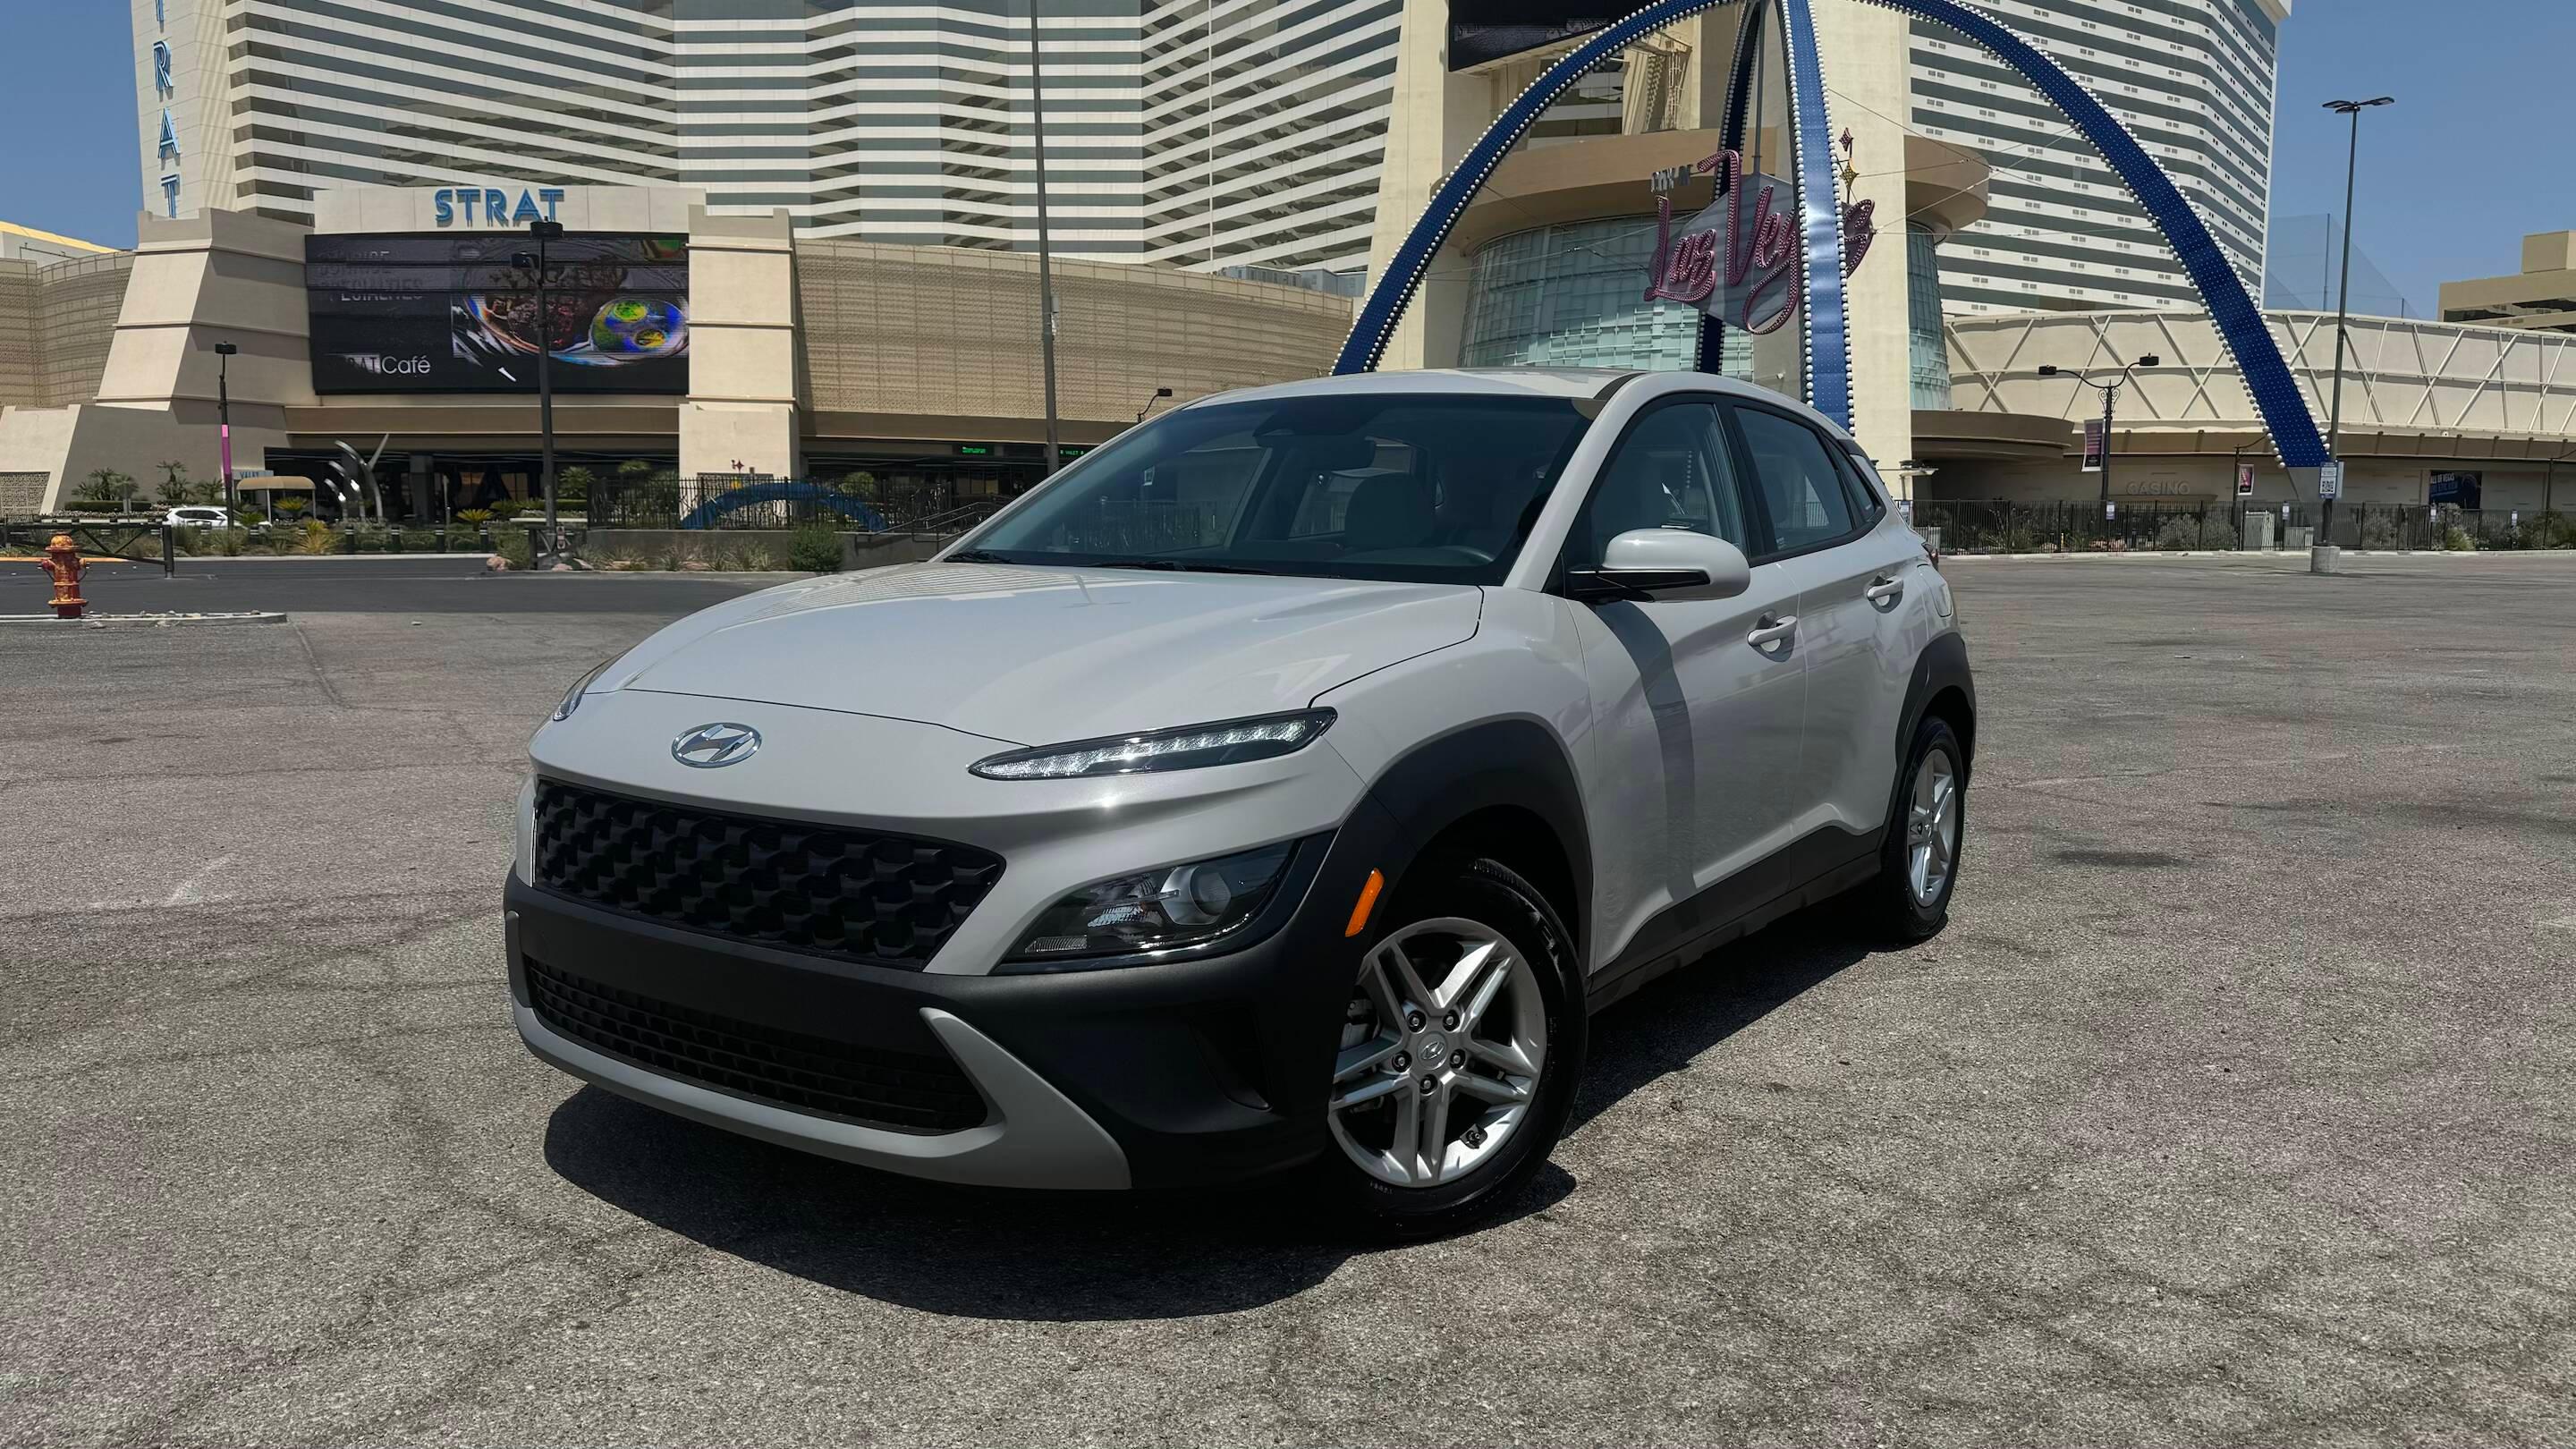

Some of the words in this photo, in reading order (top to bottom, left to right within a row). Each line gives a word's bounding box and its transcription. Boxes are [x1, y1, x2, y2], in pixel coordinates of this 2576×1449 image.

[435, 188, 564, 226] STRAT
[1644, 194, 1717, 302] Las
[1697, 148, 1875, 335] Vegs
[381, 354, 431, 374] Café
[2126, 479, 2190, 496] CASINO
